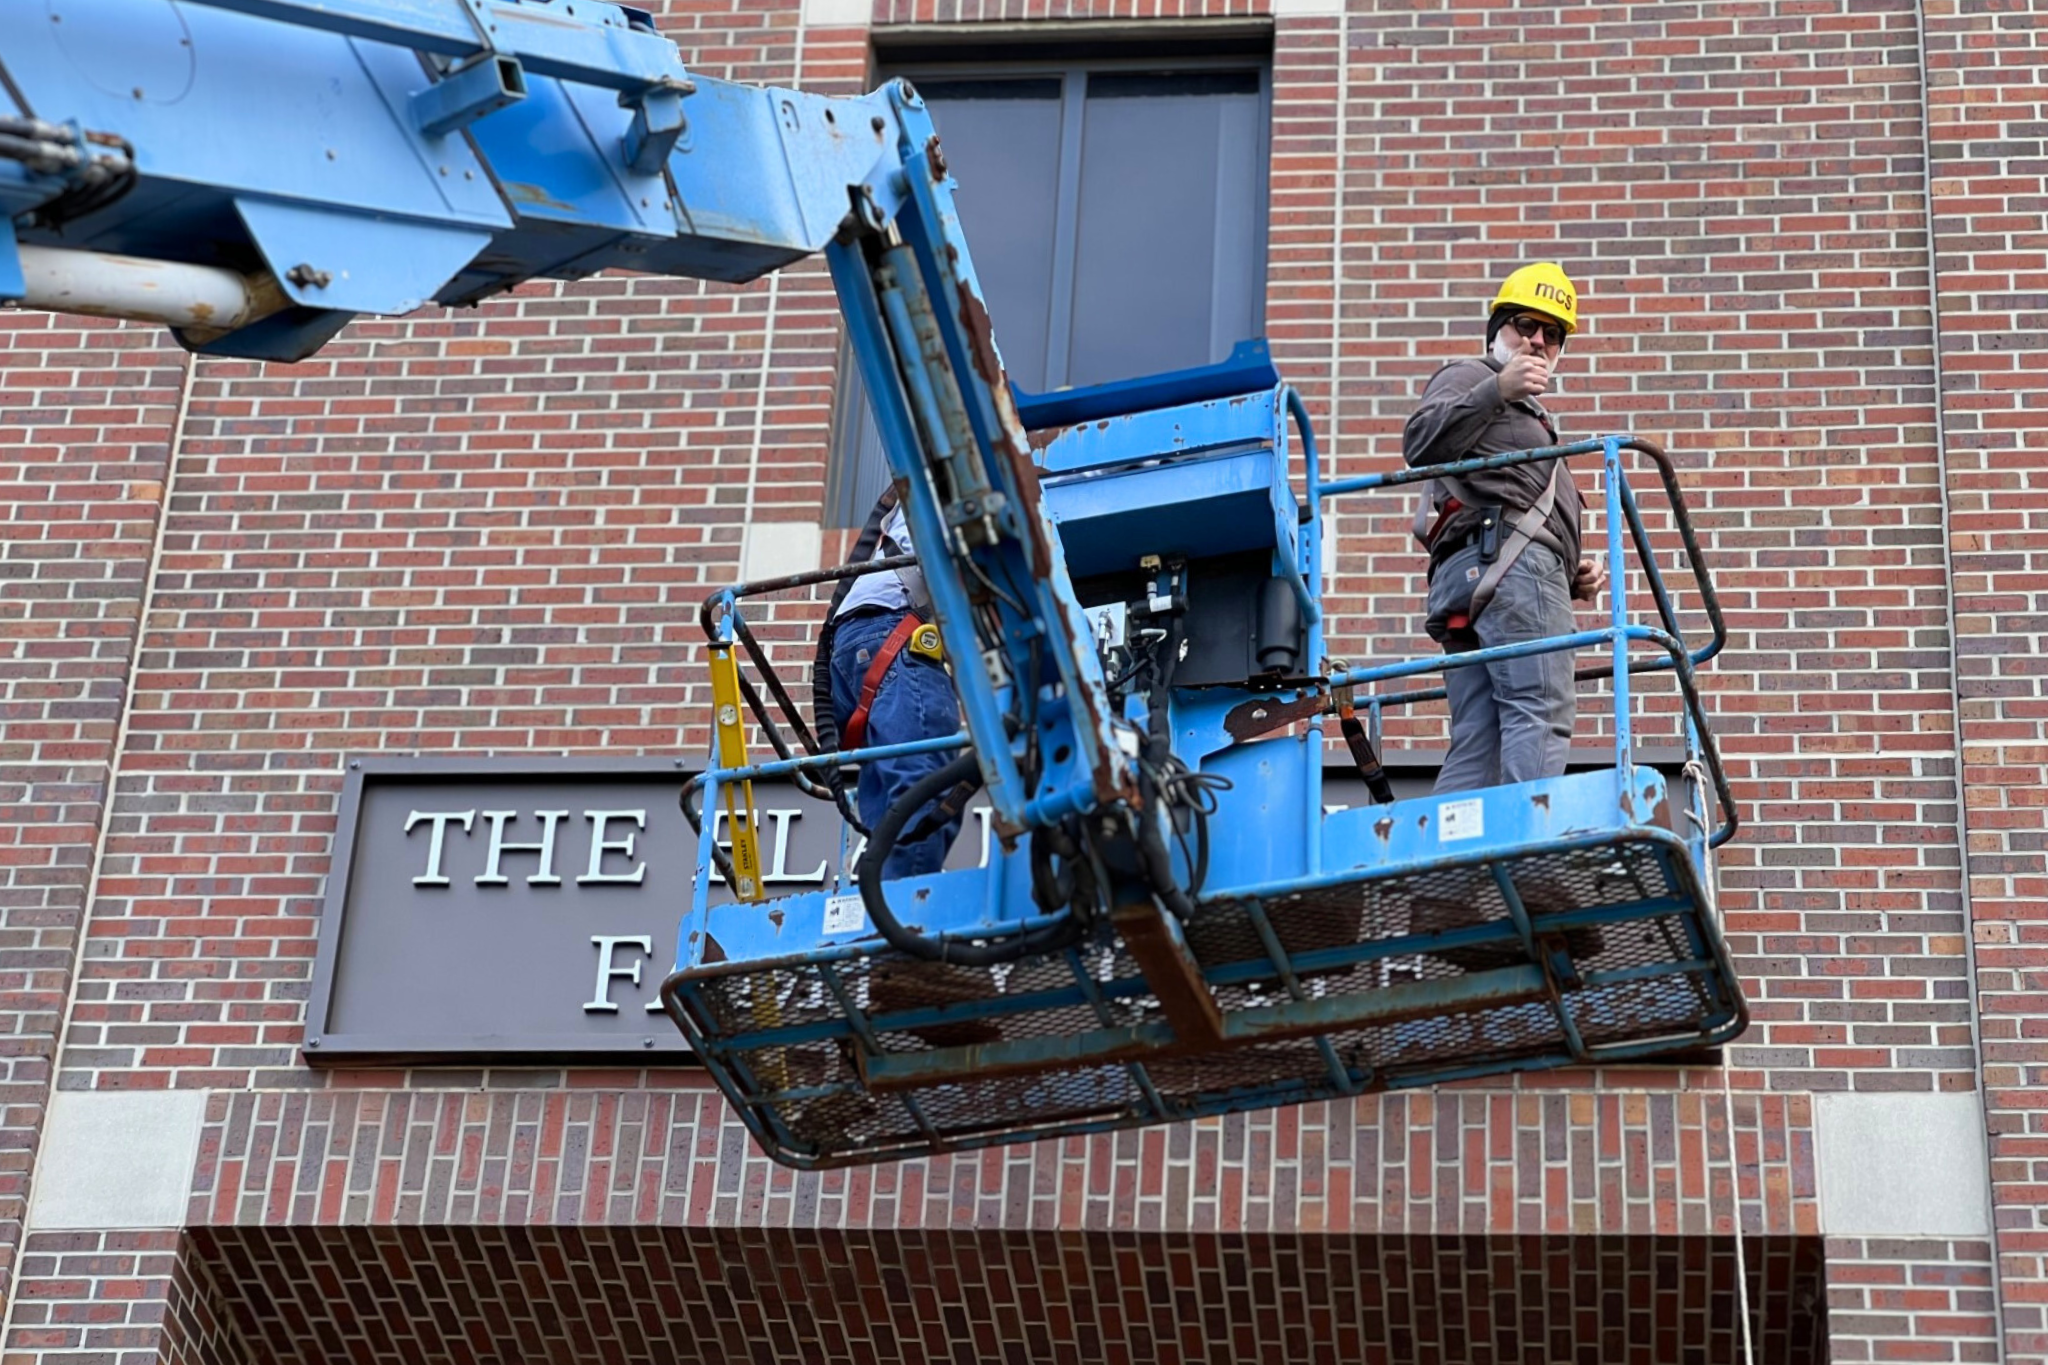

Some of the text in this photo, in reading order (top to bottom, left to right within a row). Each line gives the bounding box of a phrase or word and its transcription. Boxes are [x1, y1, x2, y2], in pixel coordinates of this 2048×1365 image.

[1535, 282, 1573, 311] mcs
[403, 808, 647, 885] THE
[740, 839, 750, 870] STANLEY
